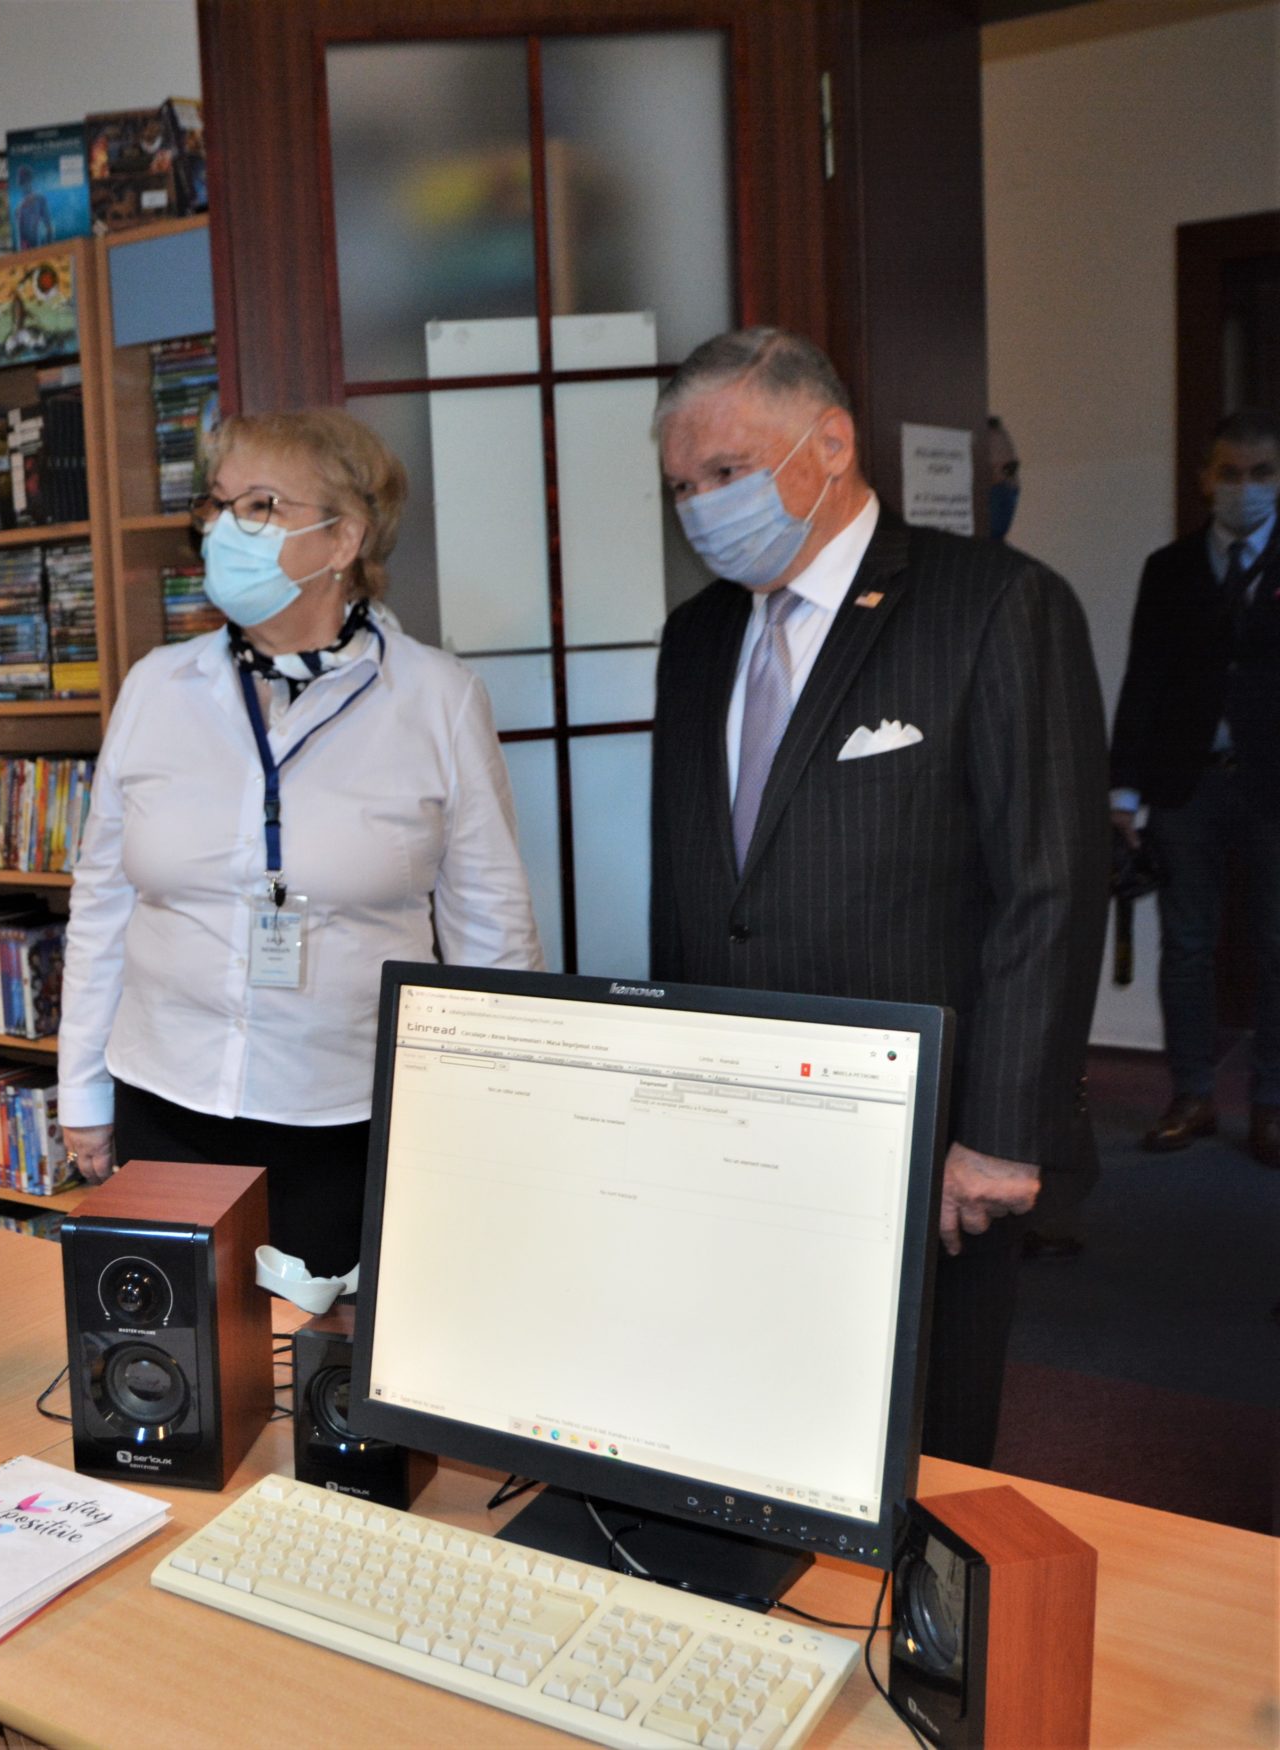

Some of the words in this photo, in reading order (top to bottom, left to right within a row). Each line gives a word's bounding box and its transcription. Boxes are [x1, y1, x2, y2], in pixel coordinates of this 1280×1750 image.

[608, 982, 665, 998] lenovo
[406, 1022, 456, 1034] tinread
[132, 1453, 172, 1466] serioux
[58, 1499, 115, 1526] stay
[0, 1509, 85, 1544] positive
